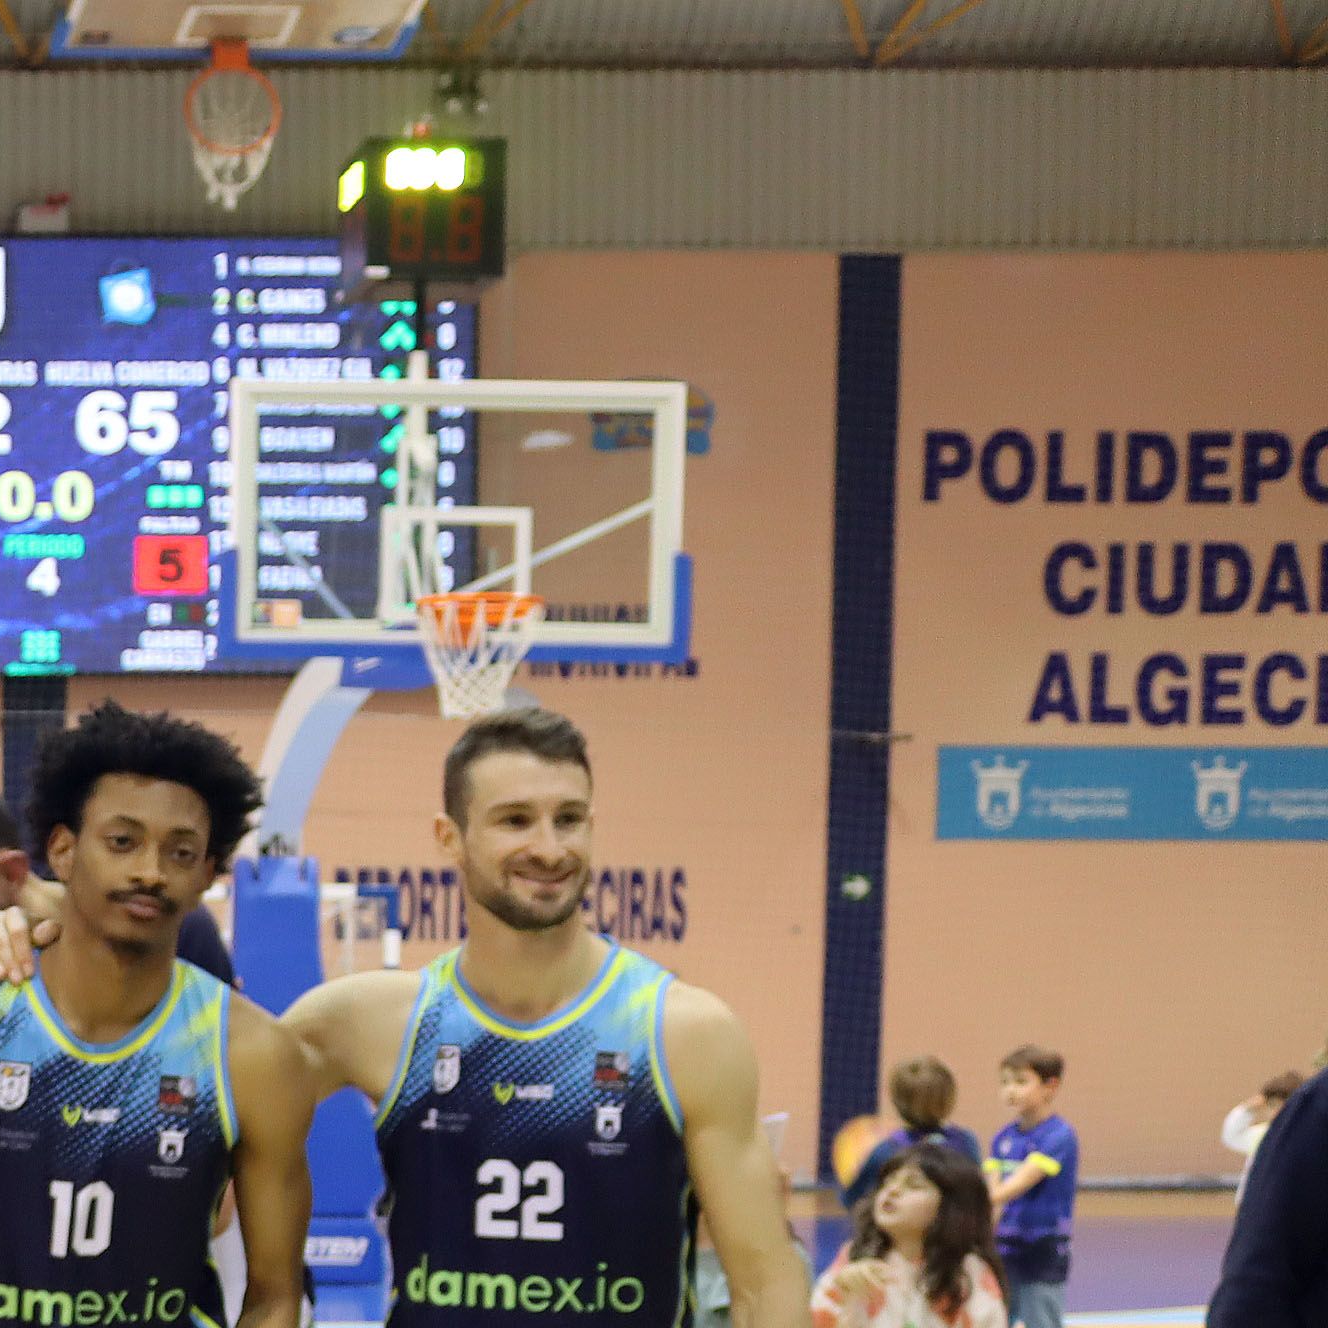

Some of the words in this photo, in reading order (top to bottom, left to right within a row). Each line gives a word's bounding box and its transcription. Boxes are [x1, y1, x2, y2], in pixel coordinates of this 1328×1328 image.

[75, 390, 180, 456] 65
[26, 557, 61, 597] 4
[159, 549, 183, 582] 5
[1046, 541, 1328, 616] CIUDA
[49, 1180, 115, 1259] 10
[475, 1157, 565, 1241] 22
[406, 1254, 645, 1313] damex.io
